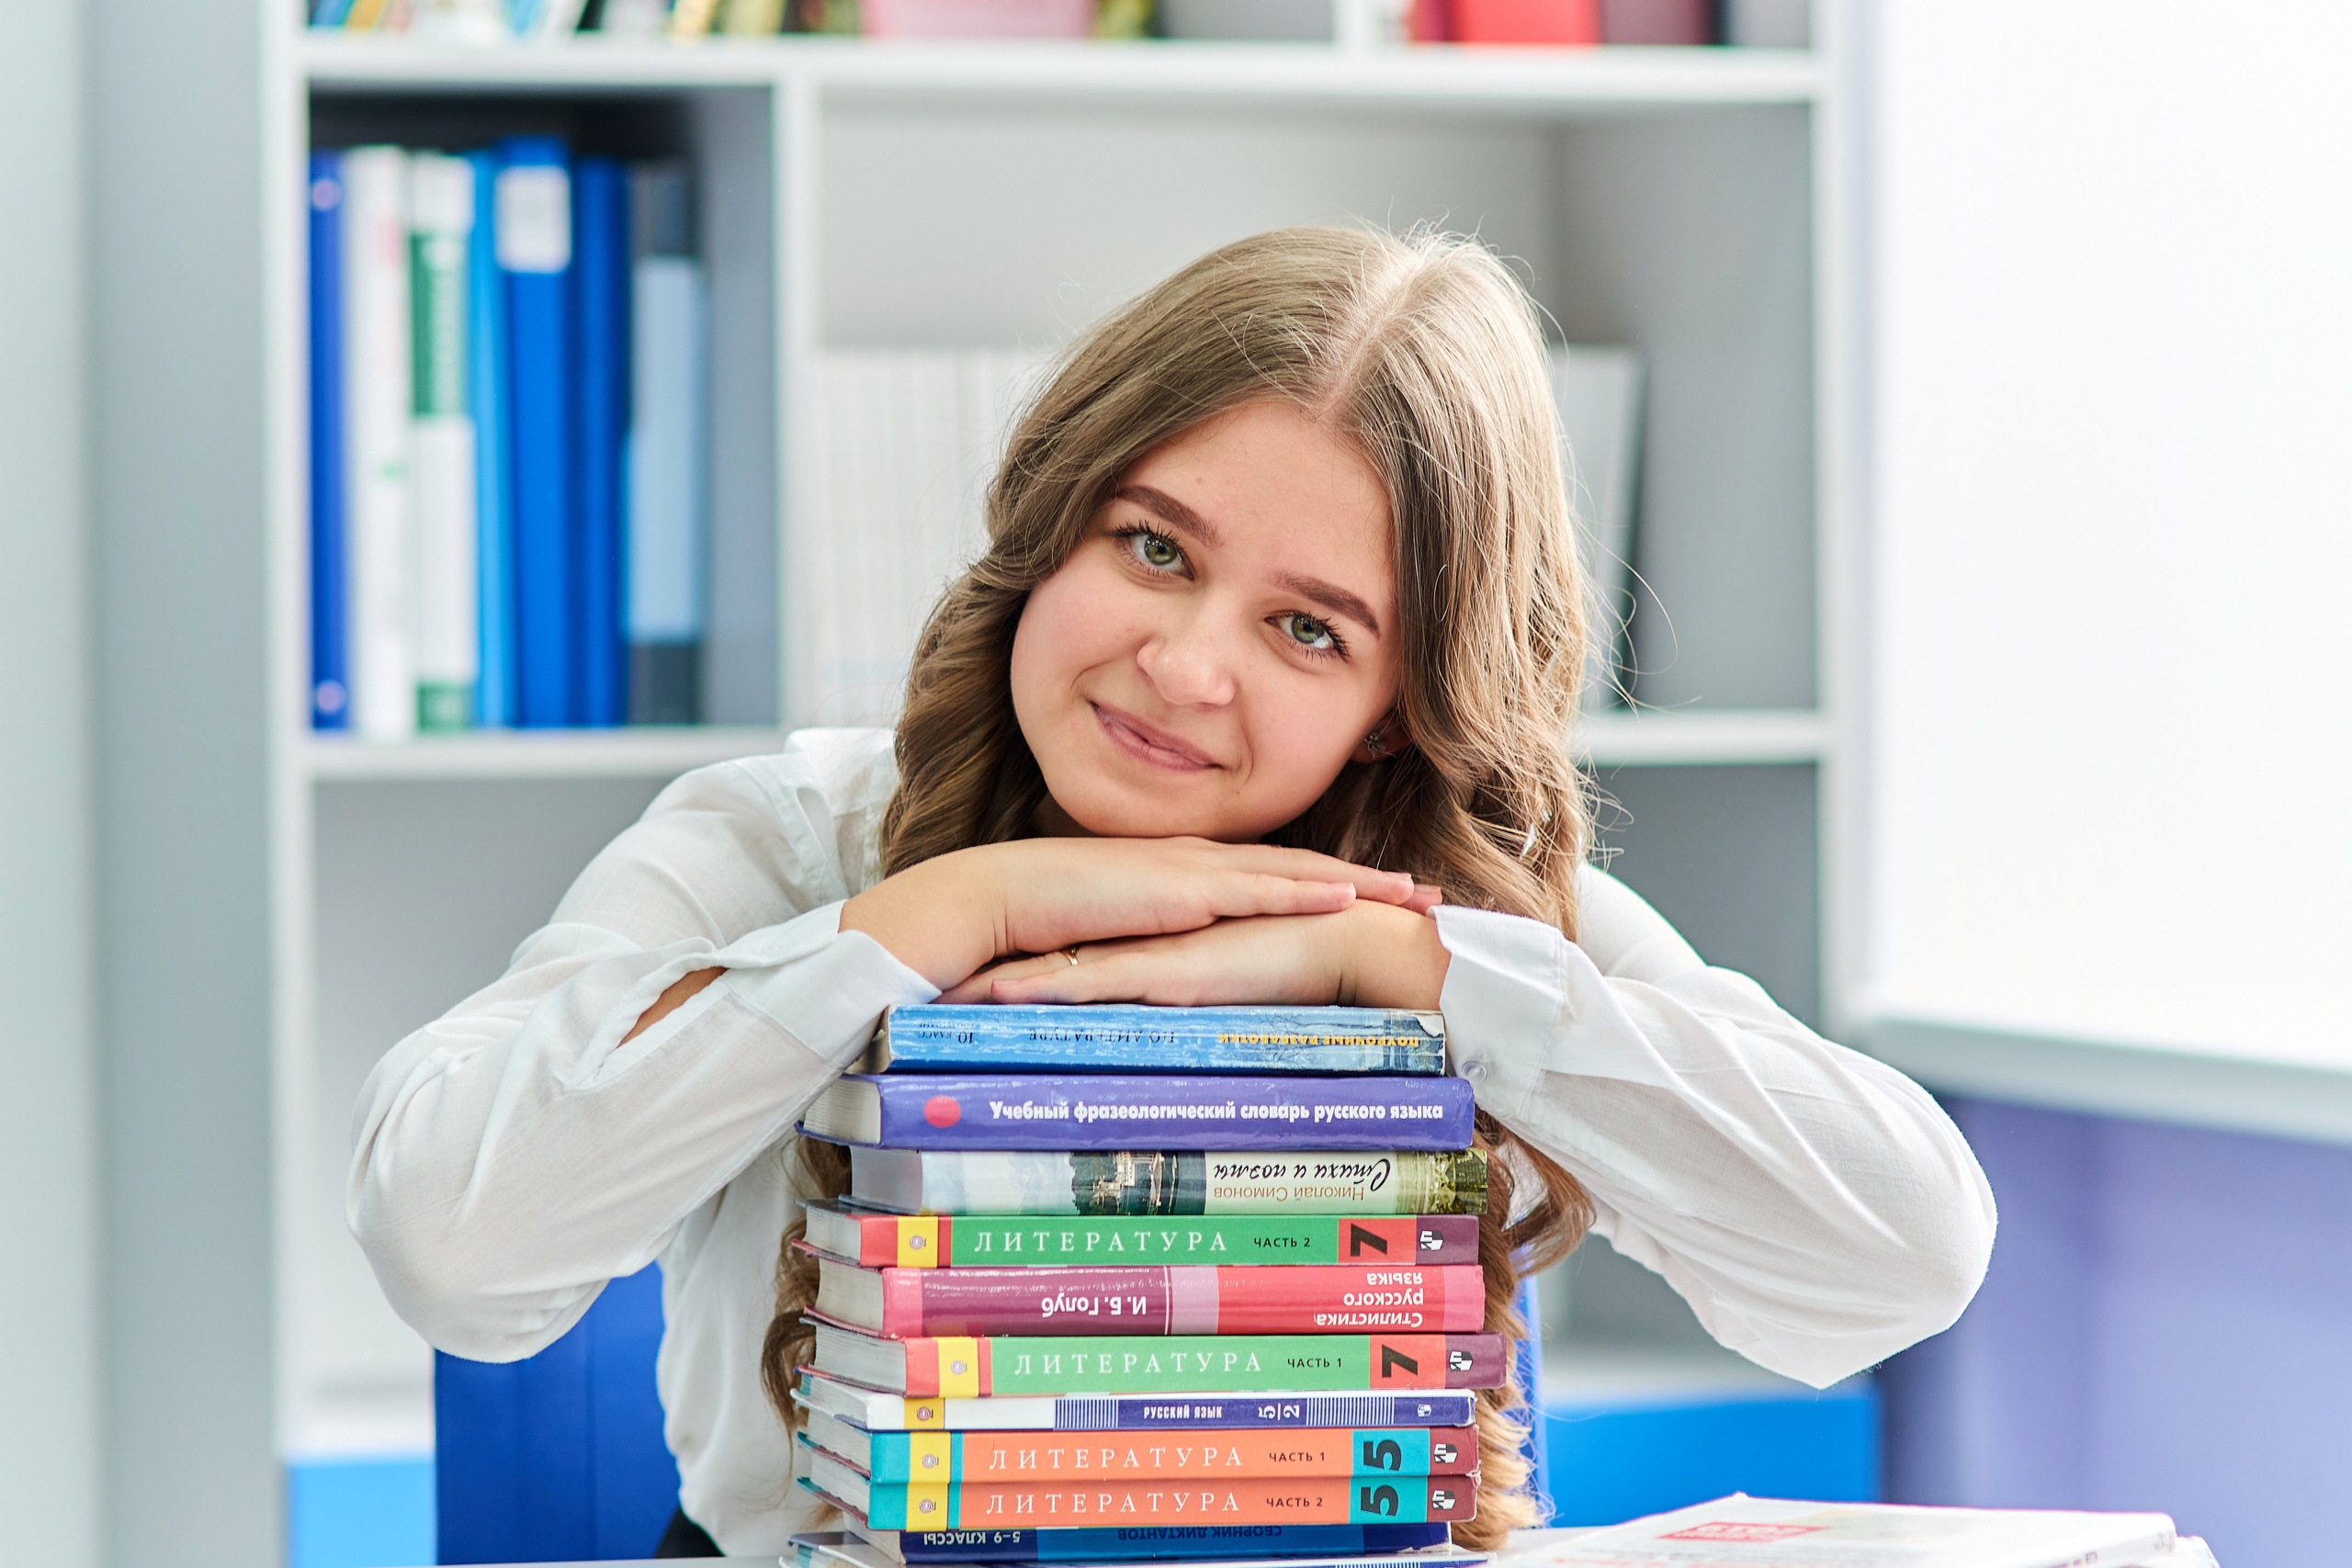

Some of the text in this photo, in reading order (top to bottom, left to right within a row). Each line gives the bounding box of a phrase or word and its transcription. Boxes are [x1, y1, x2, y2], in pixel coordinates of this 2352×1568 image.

[958, 1032, 974, 1044] 10
[1218, 1032, 1419, 1047] ПОУРОЧНЫЕ РАЗРАБОТКИ
[989, 1100, 1443, 1123] Учебный фразеологический словарь русского языка
[1213, 1157, 1391, 1192] Стихи и поэмы
[1213, 1186, 1364, 1202] Николай Симонов
[974, 1231, 1227, 1253] ЛИТЕРАТУРА
[1253, 1236, 1311, 1248] ЧАСТЬ 2
[1350, 1223, 1388, 1257] 7
[1366, 1271, 1423, 1286] языка
[1040, 1292, 1147, 1318] И. Б. Голуб
[1343, 1288, 1424, 1307] русского
[1317, 1312, 1423, 1328] Стилистика
[1014, 1352, 1261, 1375] ЛИТЕРАТУРА
[1287, 1358, 1342, 1368] ЧАСТЬ 1
[1381, 1344, 1419, 1378] 7
[1143, 1405, 1223, 1419] РУССКИЙ ЯЗЫК
[989, 1447, 1242, 1471] ЛИТЕРАТУРА
[1269, 1451, 1326, 1462] ЧАСТЬ 1
[1363, 1438, 1402, 1472] 5
[986, 1492, 1239, 1515] ЛИТЕРАТУРА
[1266, 1496, 1324, 1507] ЧАСТЬ 2
[1360, 1484, 1399, 1517] 5
[923, 1531, 987, 1545] КЛАССЫ
[1116, 1525, 1283, 1540] СБОРНИК ДИКТАНТОВ
